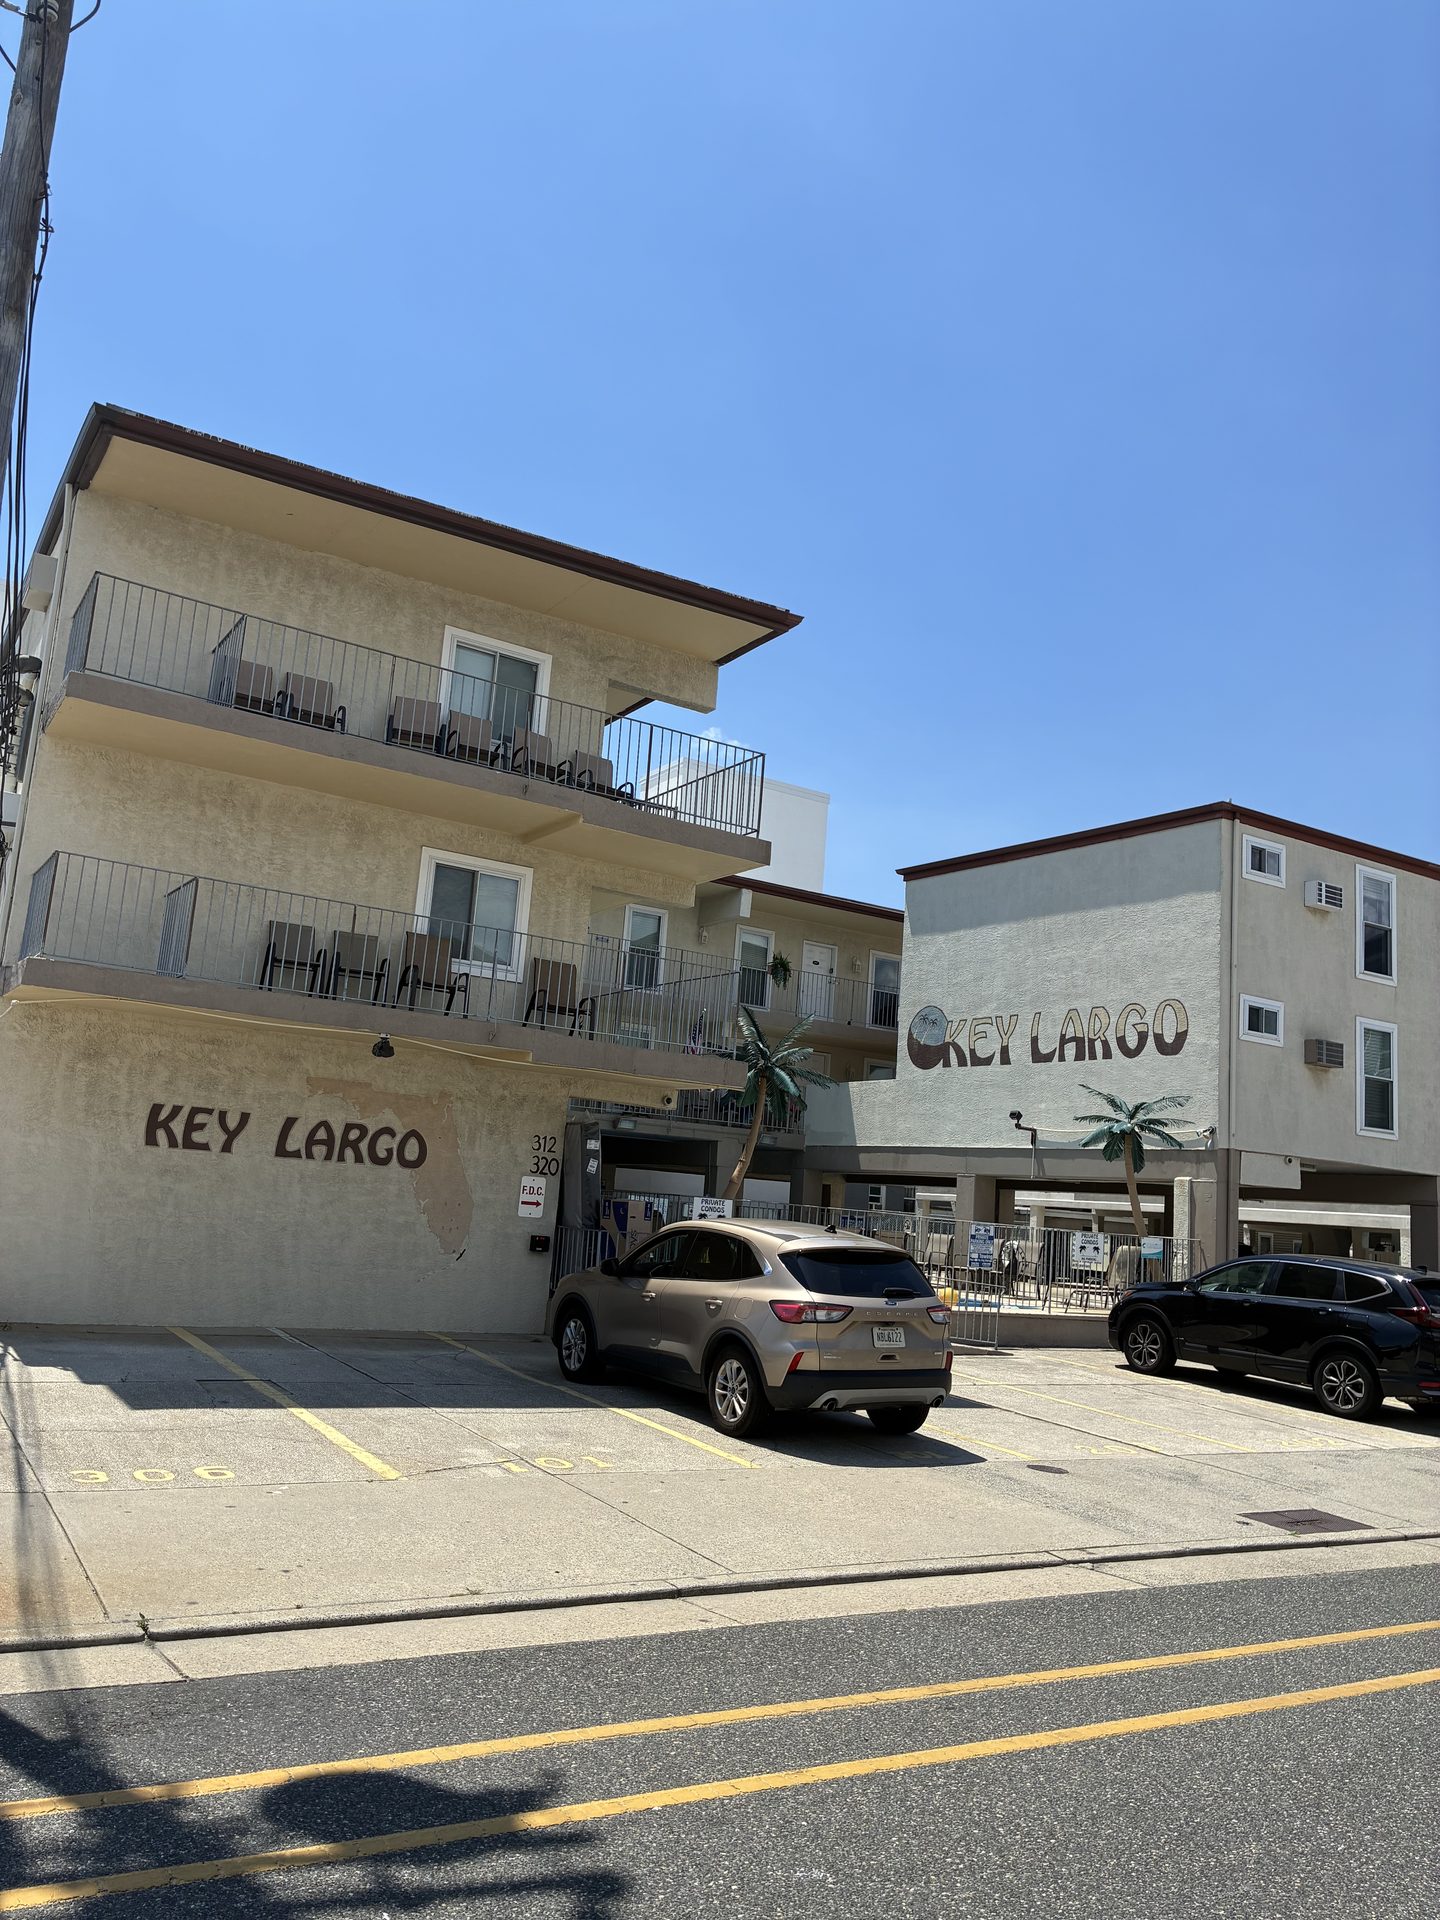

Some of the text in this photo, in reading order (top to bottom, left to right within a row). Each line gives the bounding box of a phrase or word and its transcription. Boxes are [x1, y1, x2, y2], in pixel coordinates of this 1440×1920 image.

[942, 999, 1189, 1068] KEY LARGO
[144, 1103, 428, 1169] KEY LARGO
[531, 1134, 557, 1154] 312
[529, 1155, 560, 1176] 320
[521, 1185, 544, 1196] F.D.C.
[700, 1205, 725, 1214] CONDOS
[701, 1198, 726, 1207] PRIVATE
[1080, 1232, 1099, 1240] PRIVATE
[1080, 1238, 1099, 1246] CONDOS
[496, 1455, 614, 1473] 101
[69, 1465, 235, 1483] 306
